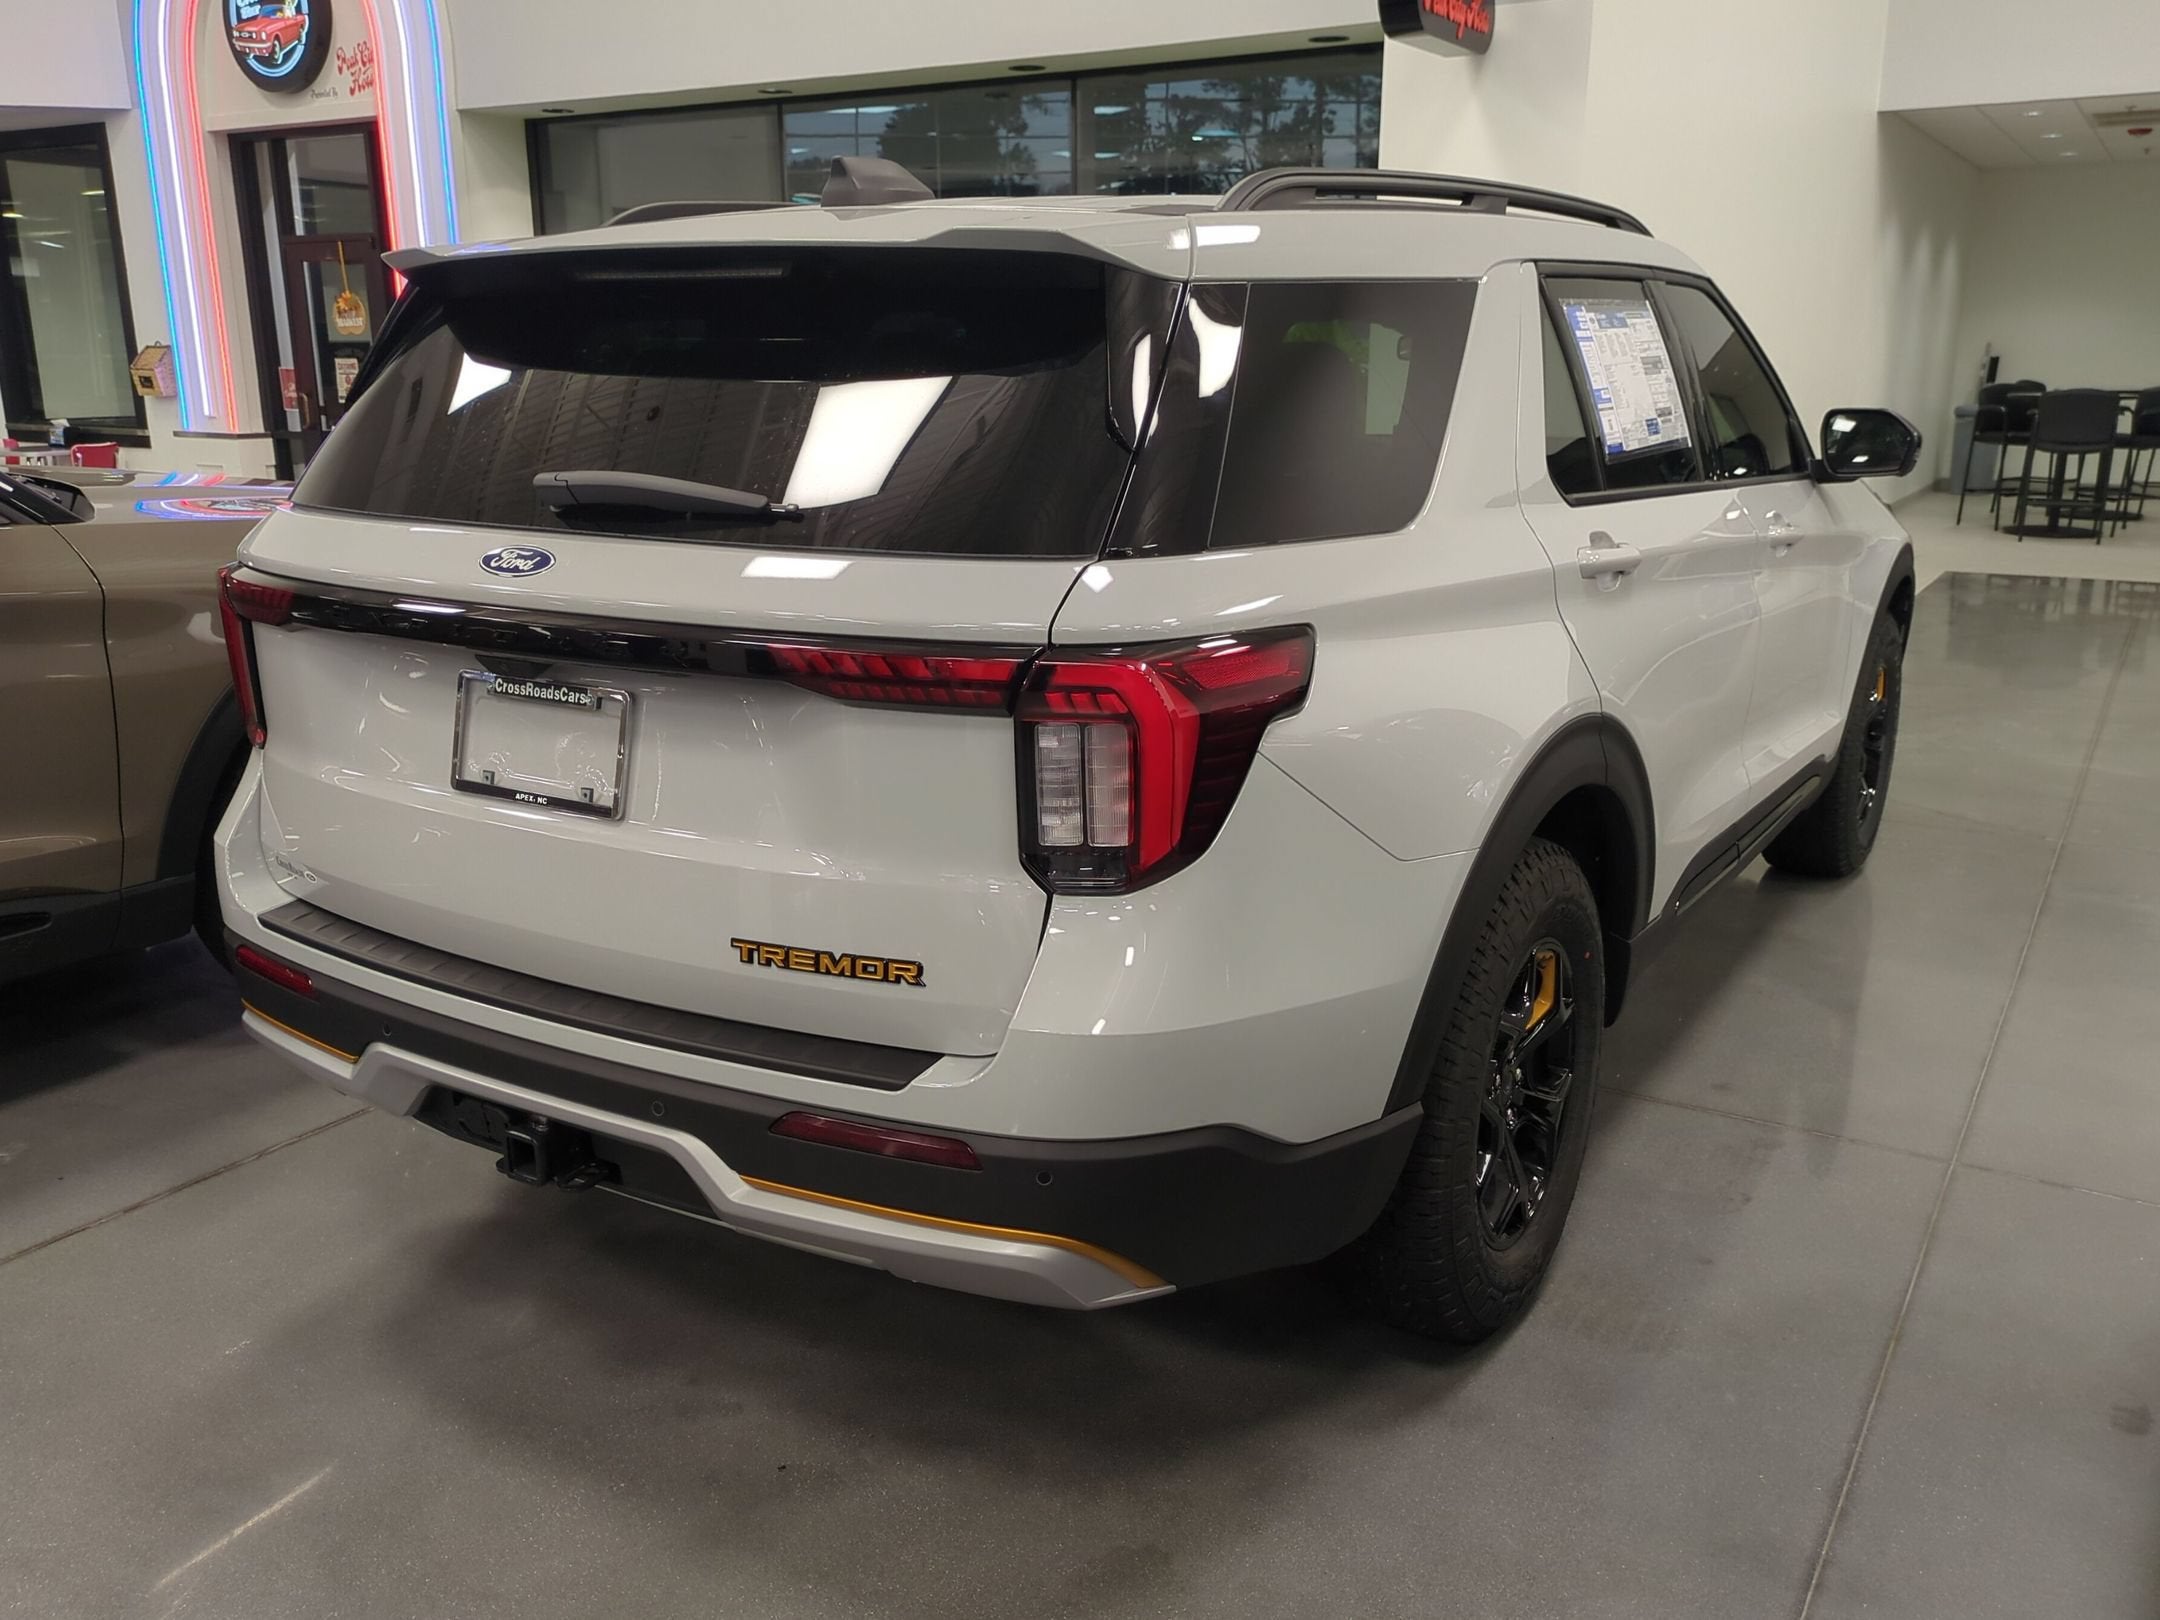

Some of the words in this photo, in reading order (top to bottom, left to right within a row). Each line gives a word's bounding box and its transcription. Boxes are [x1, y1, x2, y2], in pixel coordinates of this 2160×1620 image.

[489, 548, 542, 571] Ford
[495, 678, 588, 704] CrossRoadsCars
[537, 796, 548, 805] NC
[730, 937, 926, 987] TREMOR
